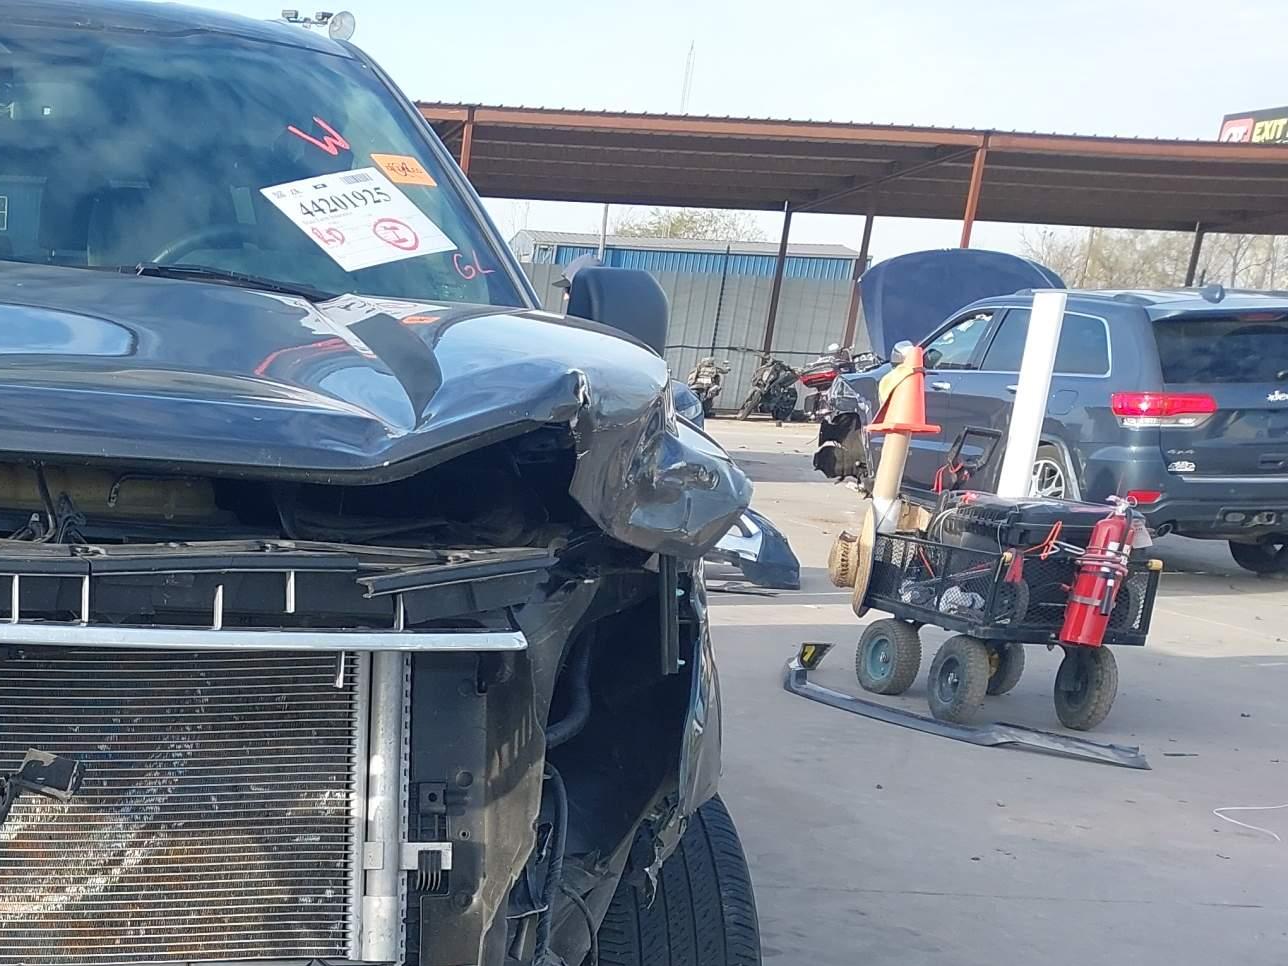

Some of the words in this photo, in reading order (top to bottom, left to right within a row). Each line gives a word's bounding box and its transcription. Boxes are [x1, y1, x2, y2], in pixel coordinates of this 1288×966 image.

[287, 115, 350, 156] W
[1252, 118, 1287, 143] EXIT
[299, 187, 392, 217] 44201925
